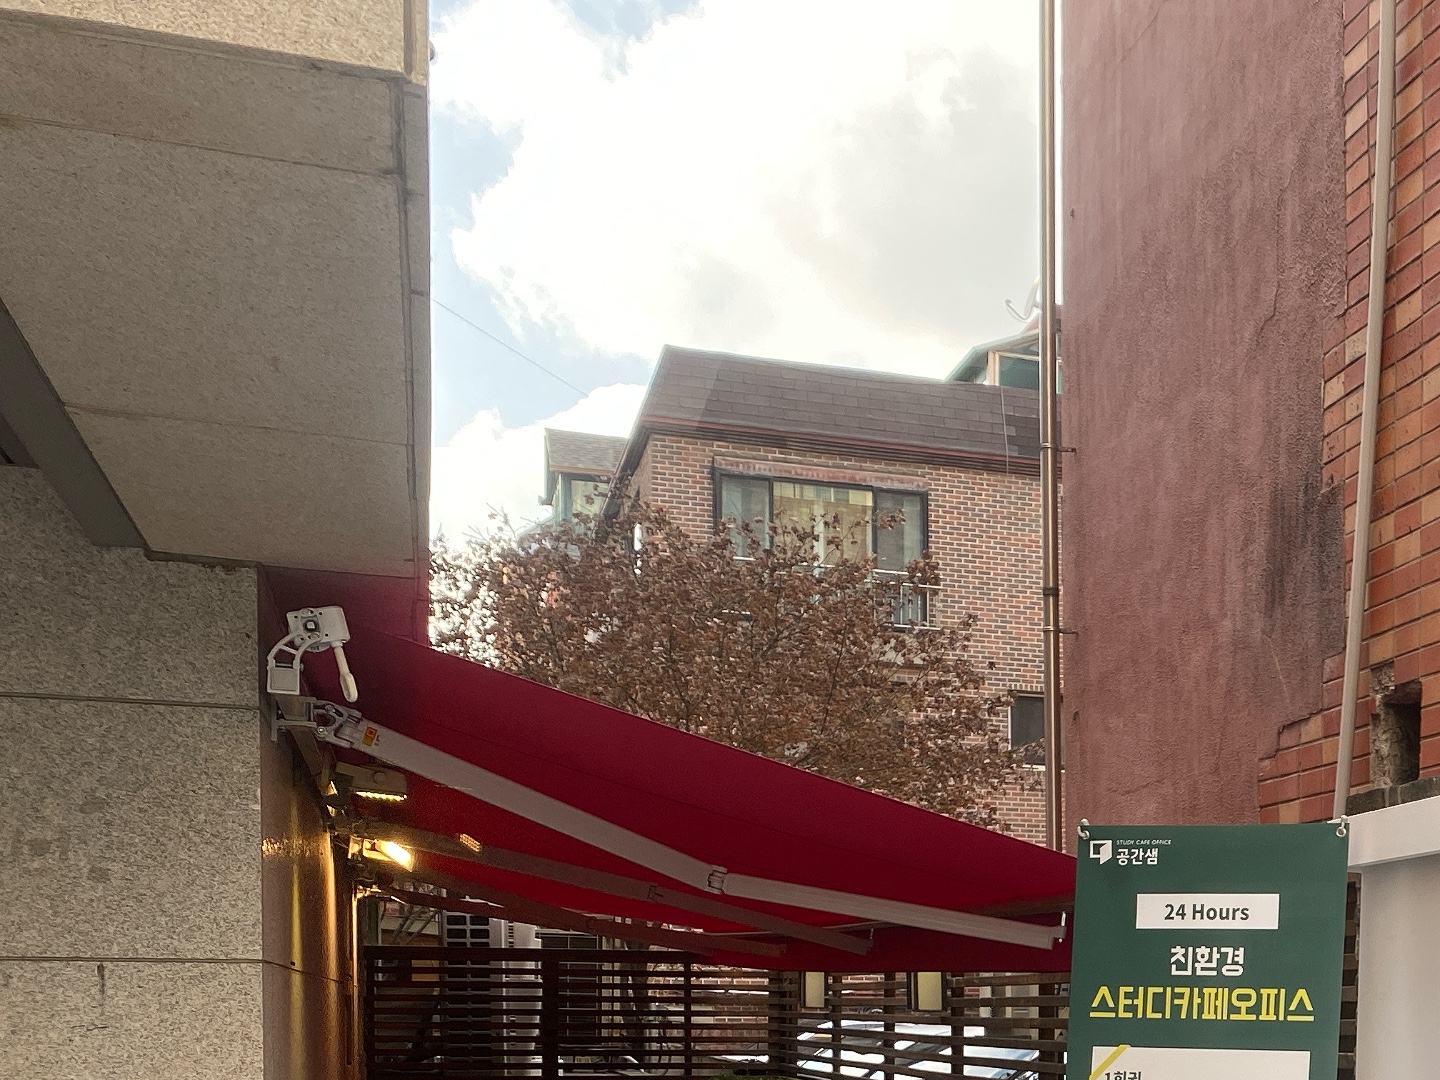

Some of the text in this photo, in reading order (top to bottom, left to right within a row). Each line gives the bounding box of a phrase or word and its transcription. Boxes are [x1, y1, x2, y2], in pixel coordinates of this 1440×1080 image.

[1116, 848, 1158, 865] 공간샘
[1164, 903, 1250, 921] 24 Hours
[1170, 945, 1245, 976] 친환경
[1089, 985, 1315, 1022] 스터디카페오피스
